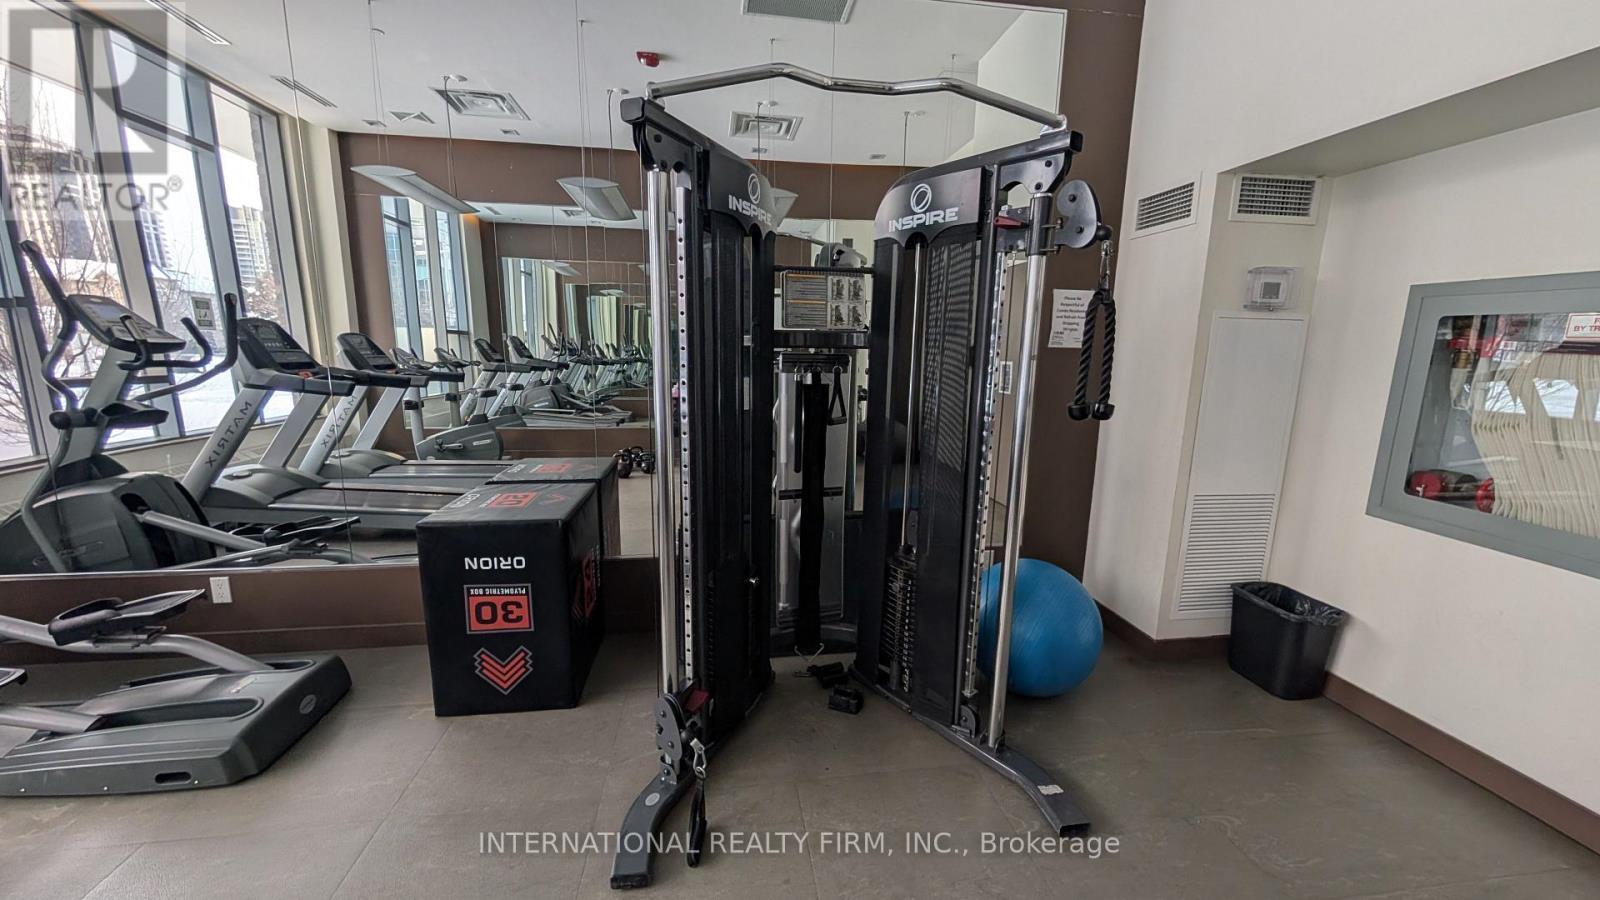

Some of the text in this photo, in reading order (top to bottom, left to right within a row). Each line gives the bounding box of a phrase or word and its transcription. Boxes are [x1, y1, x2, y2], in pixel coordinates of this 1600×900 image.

[728, 195, 772, 226] INSPIRE
[889, 207, 959, 232] INSPIRE
[464, 556, 526, 570] ORION
[485, 587, 526, 595] PLYOMETRIC
[475, 601, 523, 625] 30
